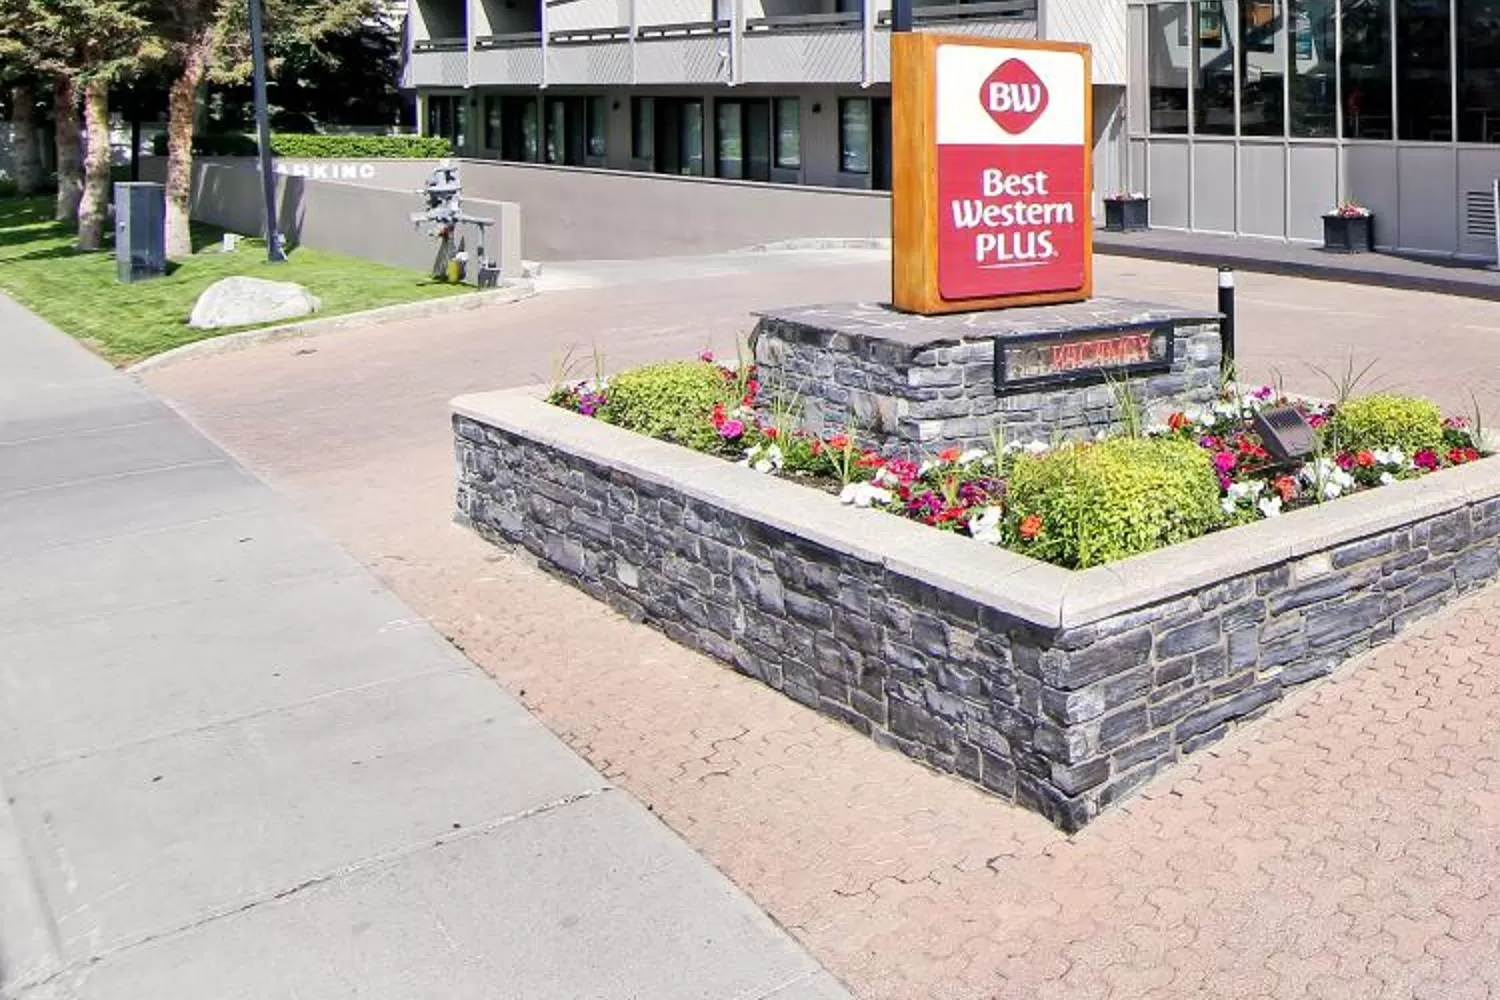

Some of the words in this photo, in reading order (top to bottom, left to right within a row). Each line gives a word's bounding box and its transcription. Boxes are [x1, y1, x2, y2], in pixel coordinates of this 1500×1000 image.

[989, 81, 1041, 113] BW
[257, 163, 375, 179] ARKING
[983, 168, 1048, 196] Best
[952, 199, 1074, 229] Western
[976, 230, 1054, 262] PLUS
